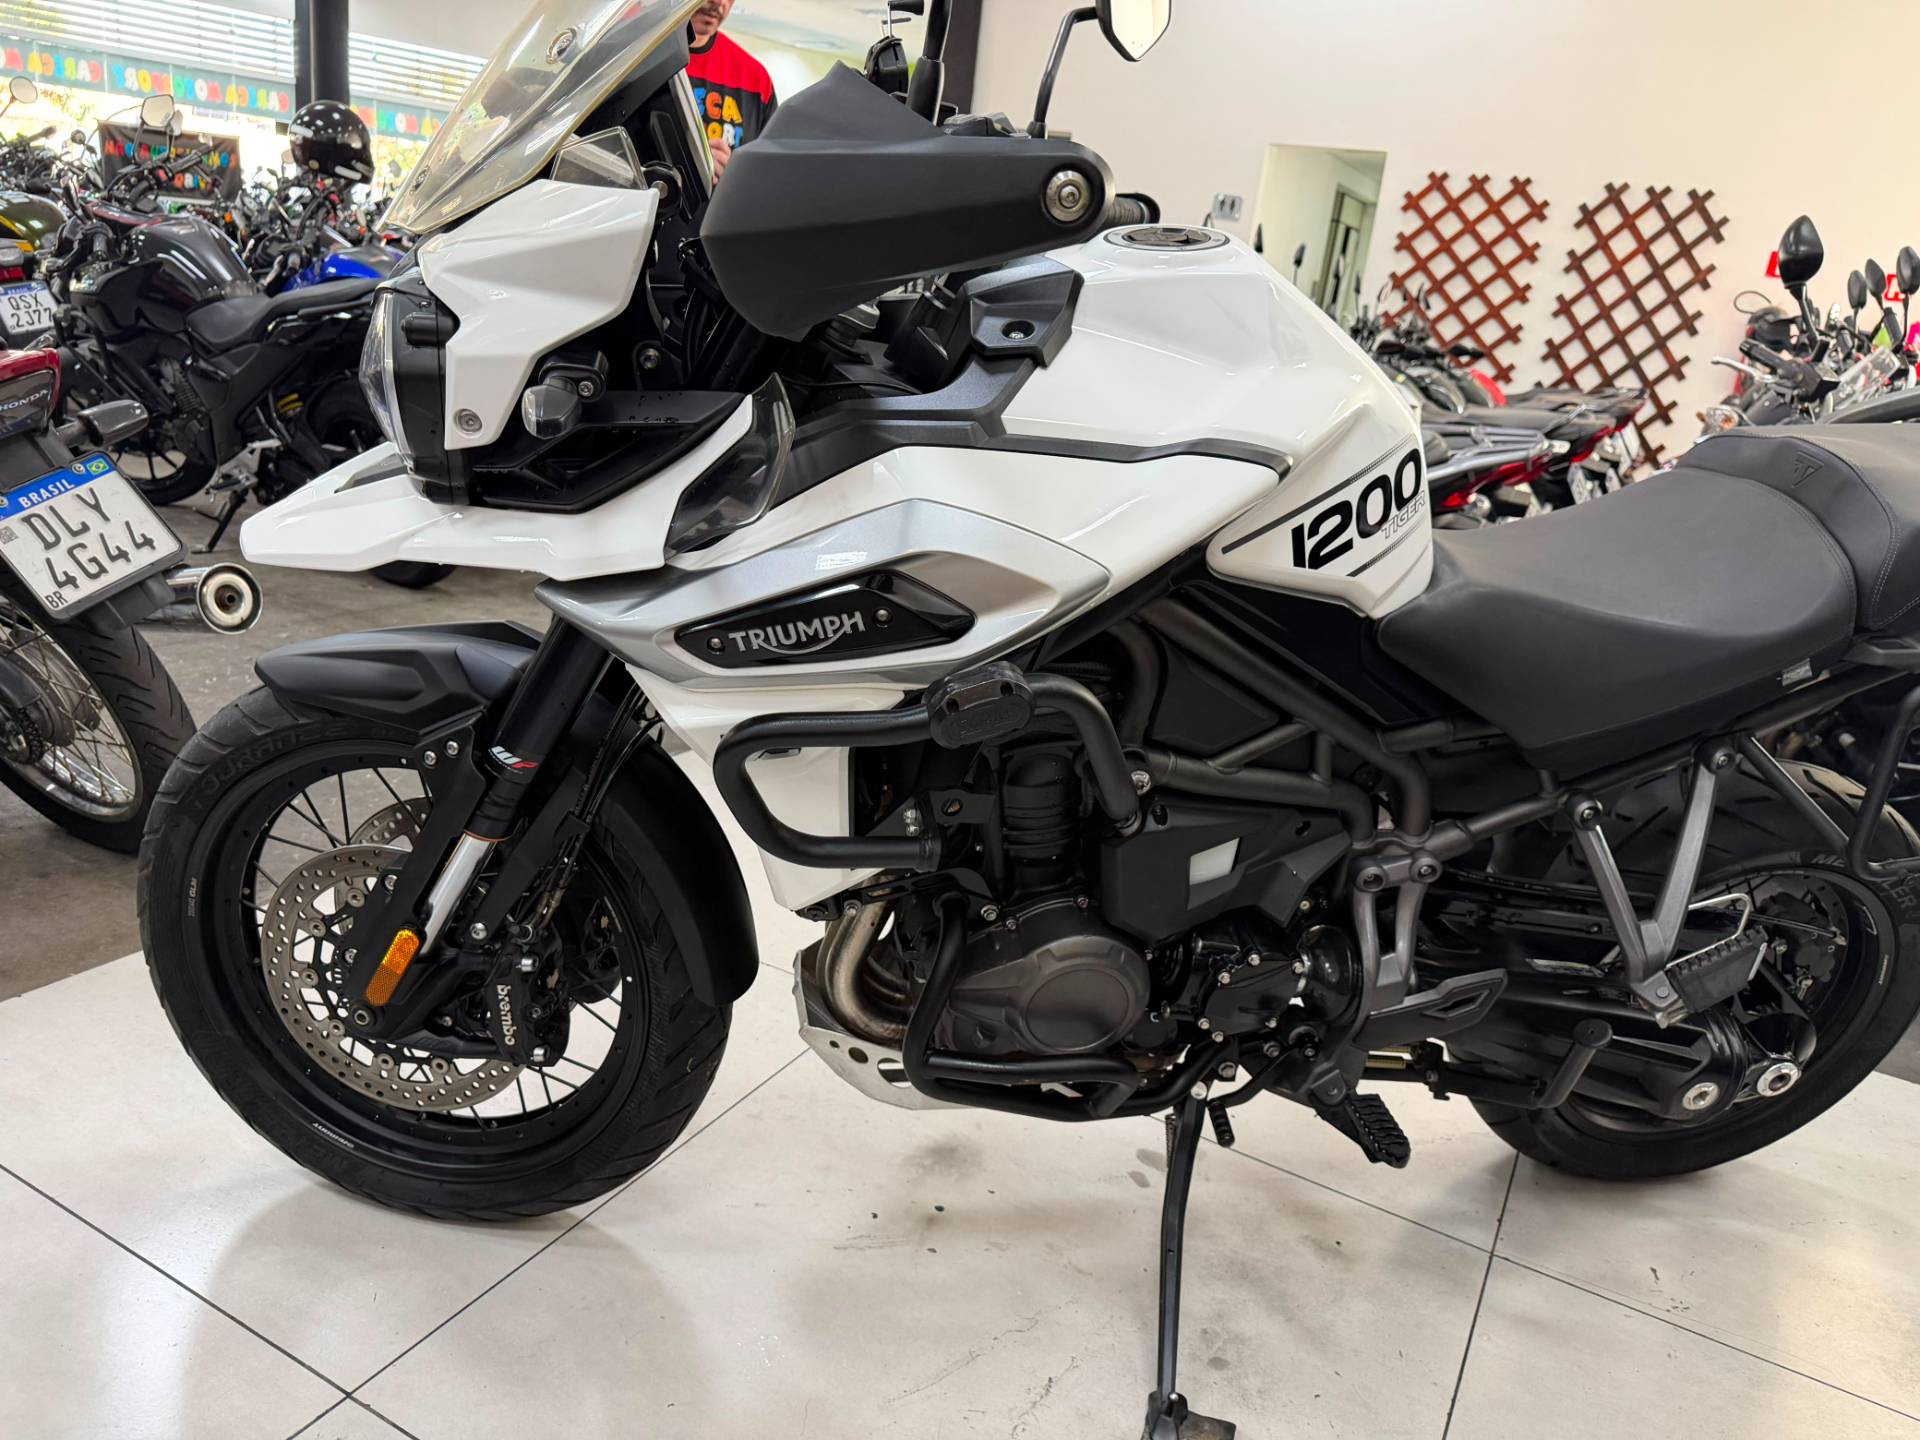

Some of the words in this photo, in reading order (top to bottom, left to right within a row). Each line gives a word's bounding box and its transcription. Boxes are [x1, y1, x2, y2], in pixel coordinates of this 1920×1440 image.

[8, 292, 43, 311] QSX
[11, 307, 52, 327] 2J77
[0, 389, 48, 411] HONDA
[18, 478, 76, 508] BRASIL
[1291, 447, 1422, 570] 1200
[1381, 490, 1427, 539] TIGER
[20, 487, 110, 550] DLY
[44, 520, 156, 589] 4G44
[45, 591, 68, 609] BR
[728, 610, 866, 655] TRIUMPH
[496, 984, 517, 1046] brembo
